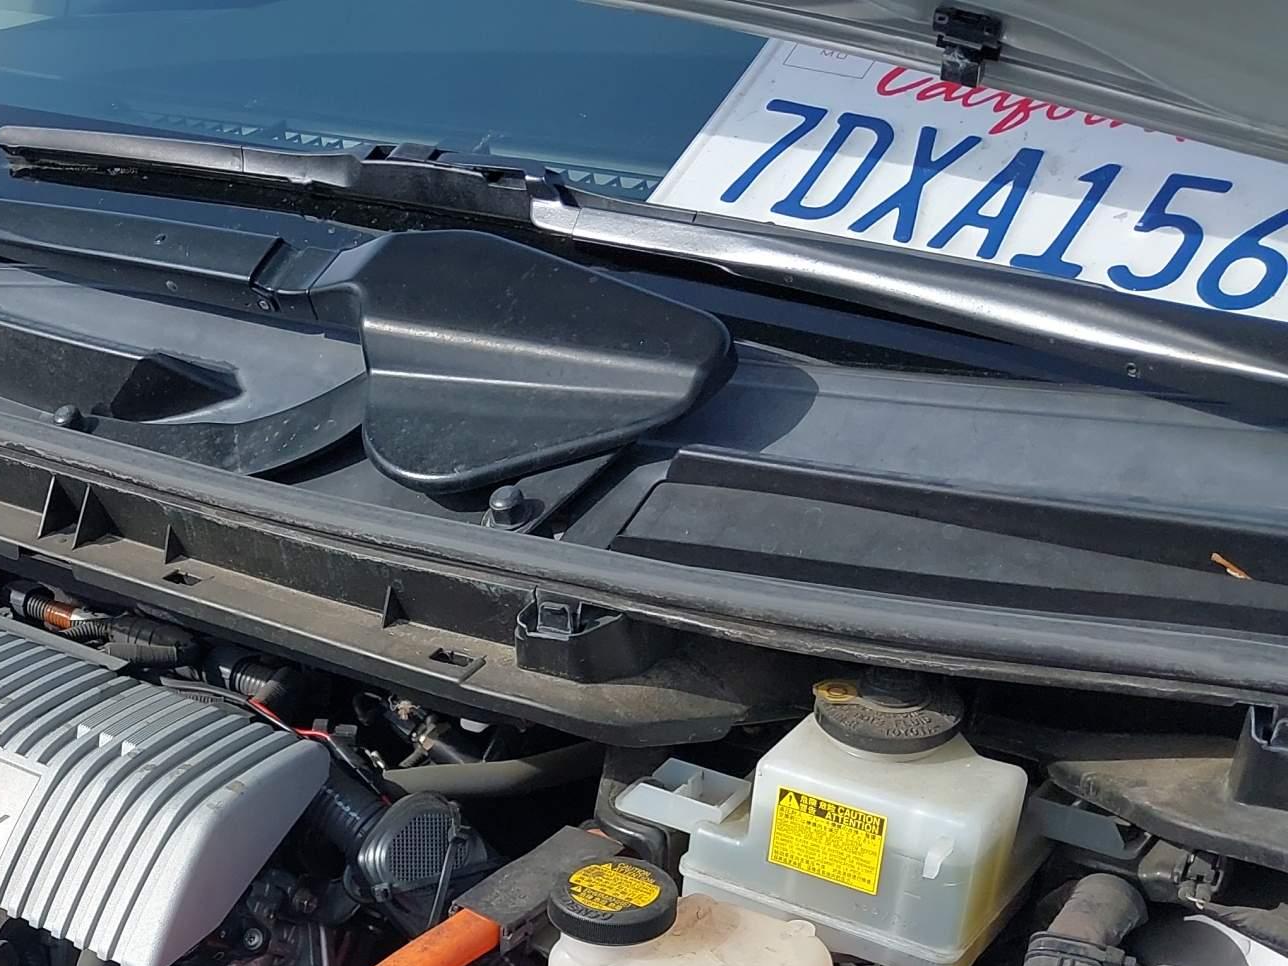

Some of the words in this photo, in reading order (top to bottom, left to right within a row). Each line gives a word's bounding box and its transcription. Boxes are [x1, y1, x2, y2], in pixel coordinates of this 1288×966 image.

[721, 98, 1288, 310] 7DXA156
[825, 812, 880, 835] ATTENTION
[837, 806, 881, 826] CAUTION
